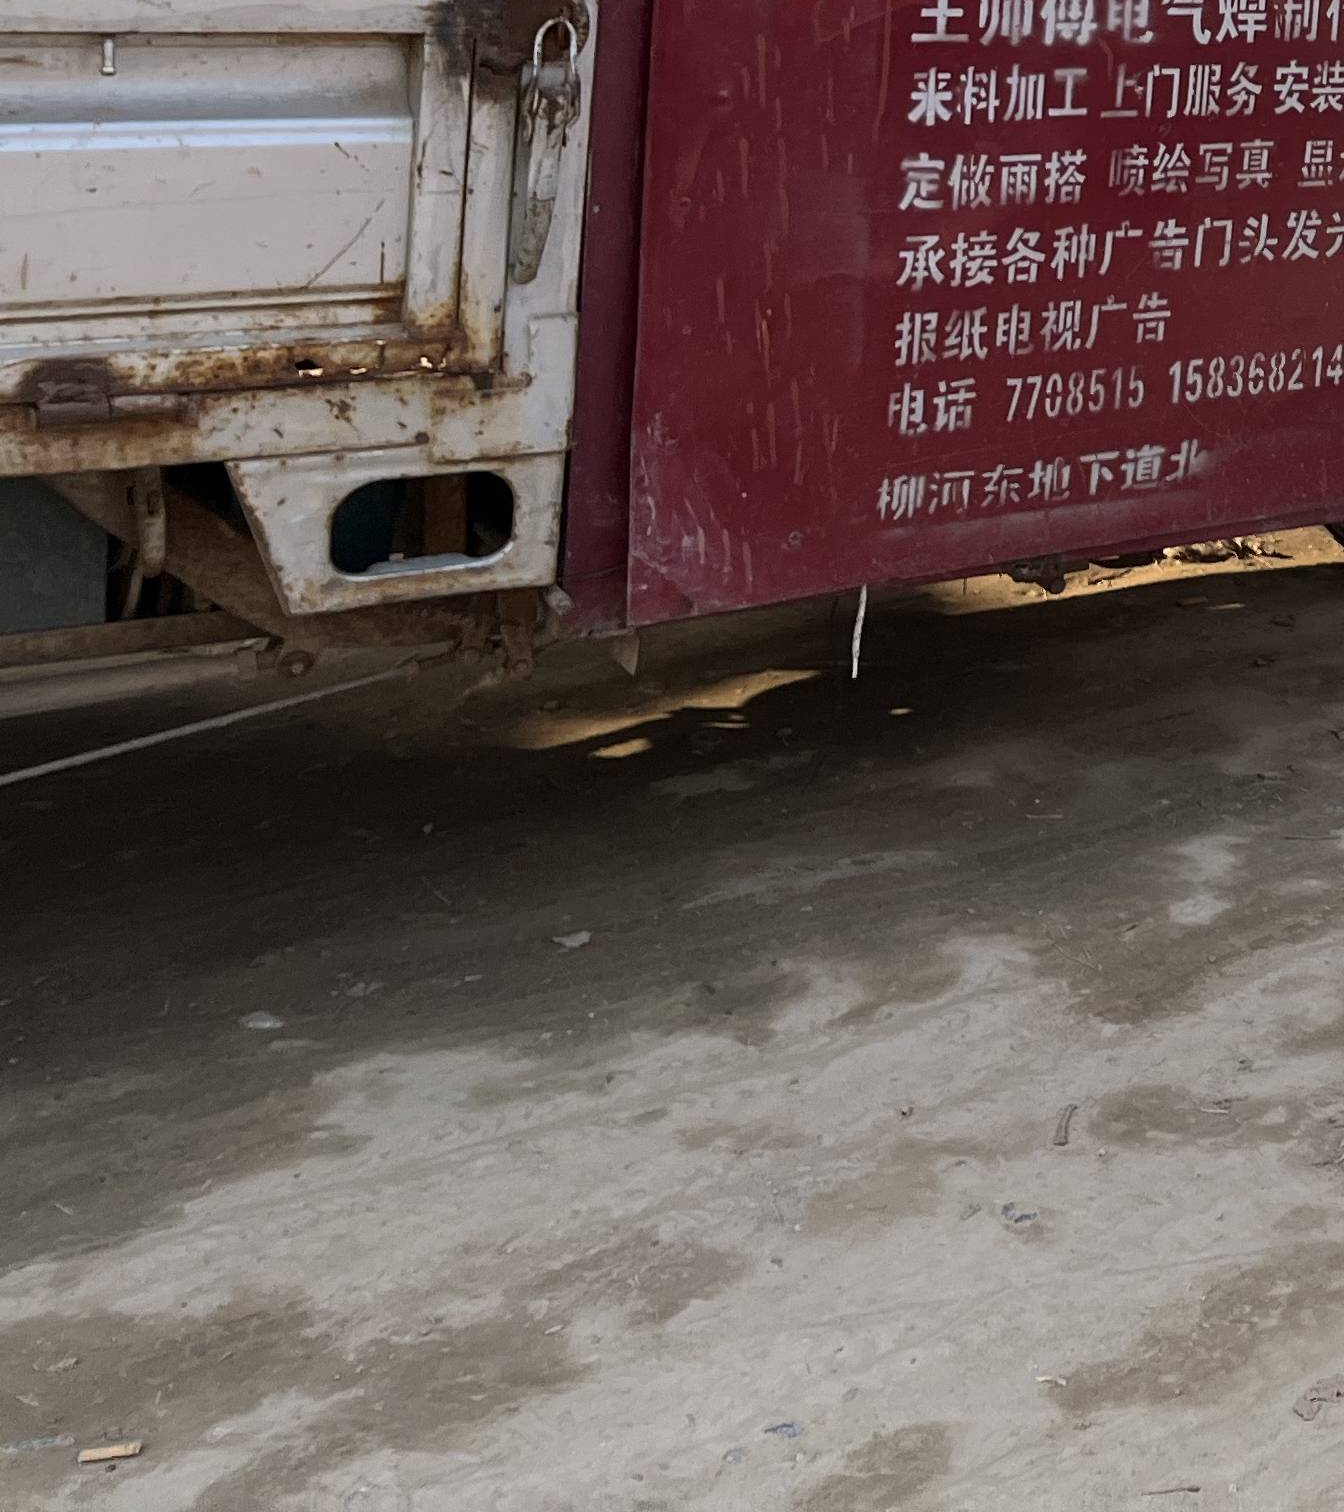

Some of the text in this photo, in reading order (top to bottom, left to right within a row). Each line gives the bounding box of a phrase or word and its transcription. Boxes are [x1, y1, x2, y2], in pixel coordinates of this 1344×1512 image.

[898, 151, 1088, 212] 定做雨搭
[1108, 138, 1276, 197] 喷绘写真
[895, 292, 1172, 367] 报纸电视广告
[888, 377, 977, 436] 电话
[1006, 363, 1145, 422] 7708515
